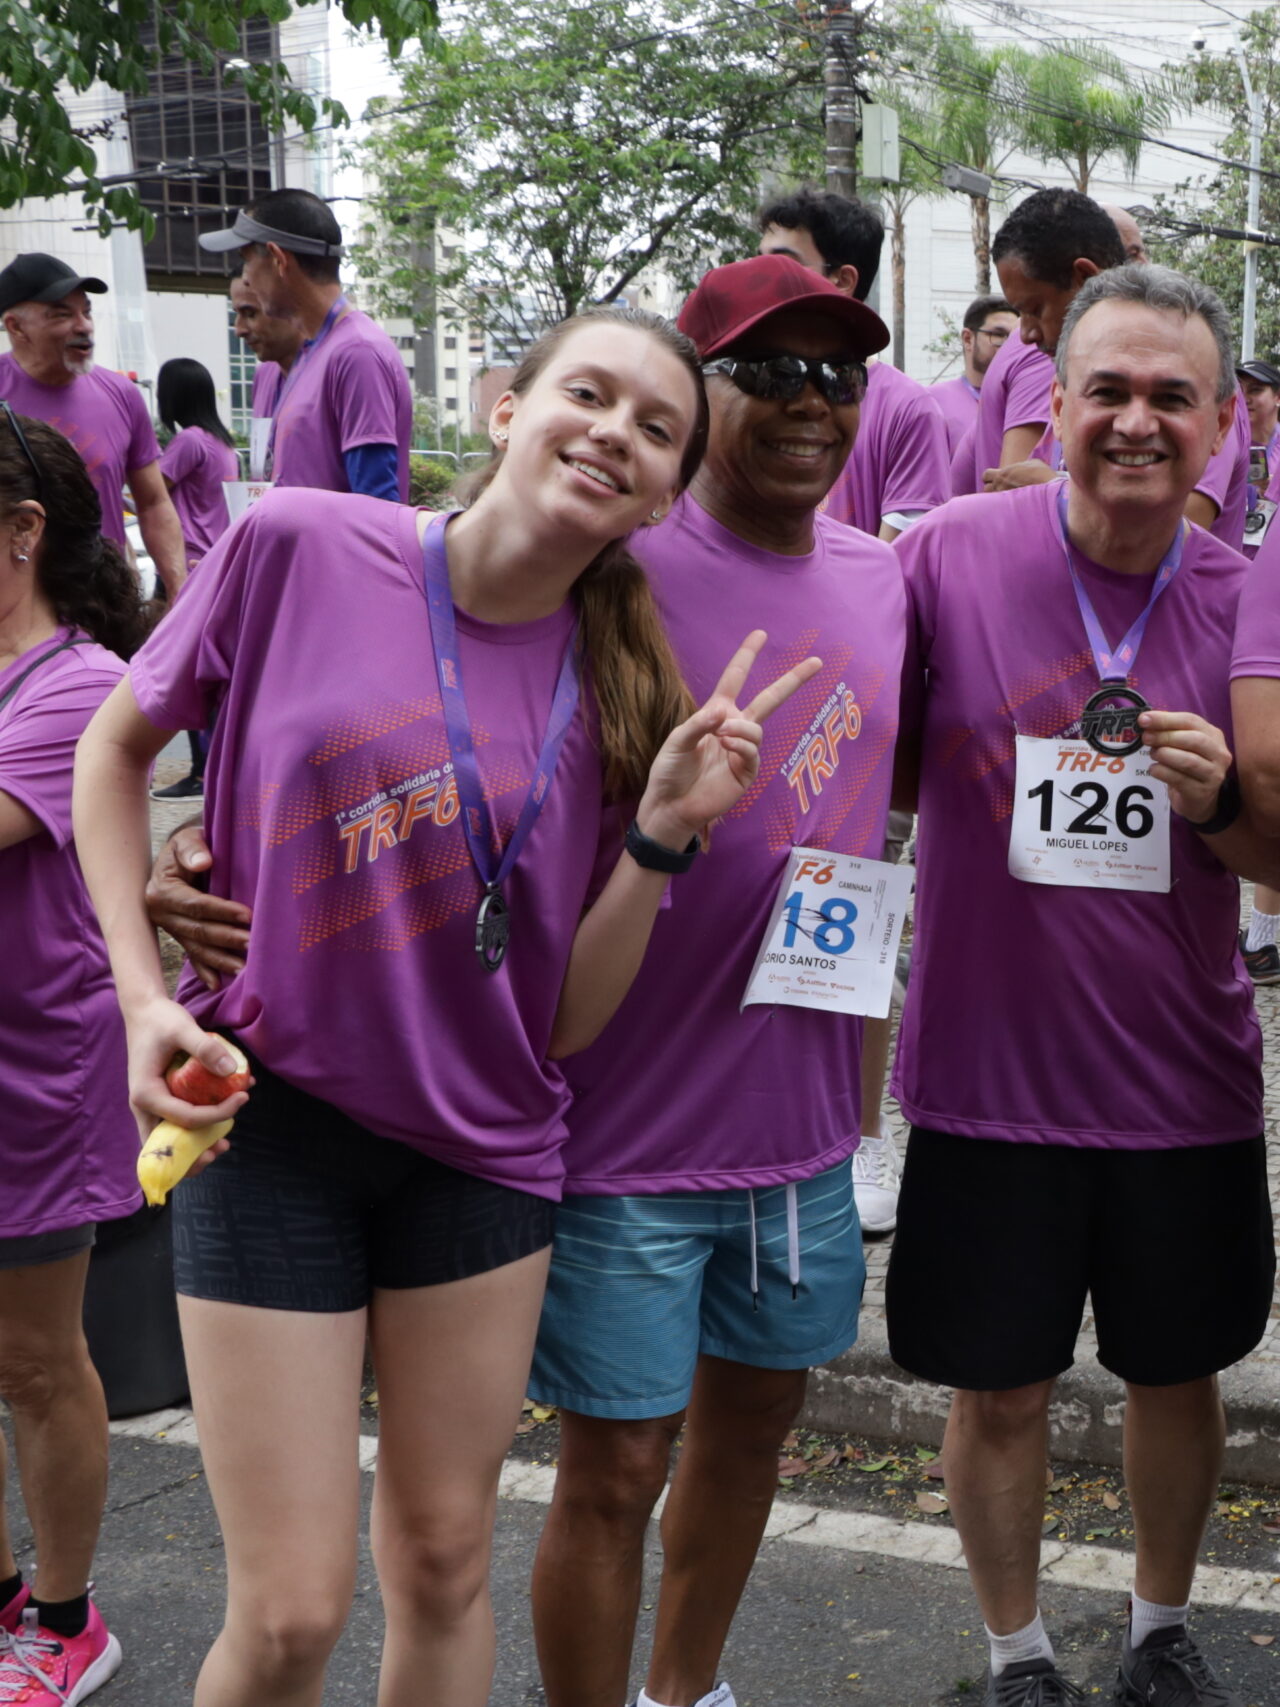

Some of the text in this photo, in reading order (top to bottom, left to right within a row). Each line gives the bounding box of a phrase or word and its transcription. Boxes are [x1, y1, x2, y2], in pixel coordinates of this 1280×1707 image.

[788, 732, 811, 766] corrida
[810, 694, 838, 734] solidária
[835, 682, 846, 695] do
[787, 689, 862, 815] TRF6
[1056, 751, 1125, 774] TRF6
[349, 791, 388, 819] corrida
[390, 768, 441, 797] solidária
[443, 762, 454, 774] d
[1027, 779, 1154, 839] 126
[340, 772, 460, 874] TRF6
[1046, 837, 1128, 852] MIGUEL LOPES
[838, 880, 873, 893] CAMINHADA
[882, 912, 895, 946] SORTEIO
[788, 953, 837, 971] SANTOS
